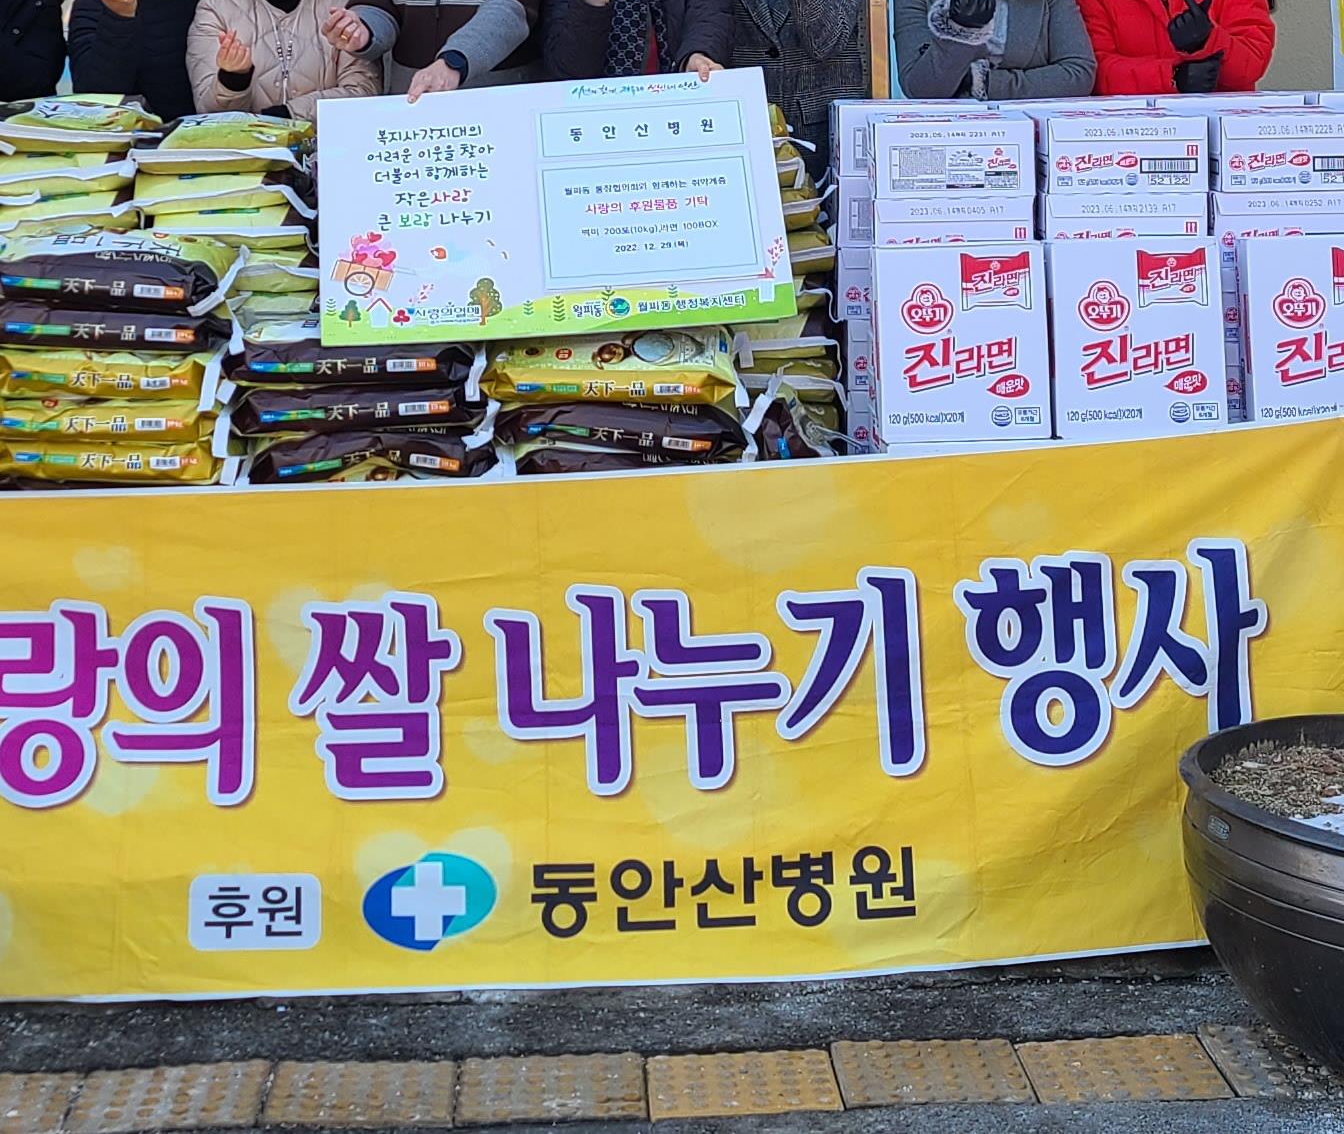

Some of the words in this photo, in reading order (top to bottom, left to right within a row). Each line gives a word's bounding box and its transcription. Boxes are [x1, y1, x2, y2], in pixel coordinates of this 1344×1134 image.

[376, 125, 482, 146] 복지사각지대의
[367, 148, 412, 163] 어려운
[418, 145, 456, 162] 이웃을
[460, 143, 495, 159] 찾아
[375, 167, 420, 185] 더불어
[425, 163, 489, 181] 함께하는
[585, 202, 623, 215] 사랑의
[378, 213, 392, 231] 큰
[439, 209, 491, 226] 나누기
[63, 276, 127, 297] 天下一品
[973, 271, 1021, 292] 진라면
[1148, 267, 1196, 290] 진라면
[910, 307, 944, 323] 오뚜기
[1088, 304, 1121, 320] 오뚜기
[1282, 301, 1317, 318] 오뚜기
[73, 322, 137, 342] 天下一品
[315, 357, 379, 375] 天下一品
[904, 335, 1017, 393] 진라면
[1081, 333, 1194, 390] 진라면
[71, 370, 133, 390] 天下一品
[583, 379, 647, 397] 天下一品
[995, 377, 1026, 395] 매운맛
[1172, 373, 1203, 392] 매운맛
[327, 401, 391, 421] 天下一品
[64, 415, 128, 433] 天下一品
[592, 425, 655, 448] 天下一品
[80, 453, 143, 471] 天下一品
[300, 599, 454, 791] 쌀
[490, 574, 918, 788] 나누기
[960, 545, 1262, 758] 행사
[529, 843, 919, 939] 동안산병원
[204, 884, 305, 940] 후원
